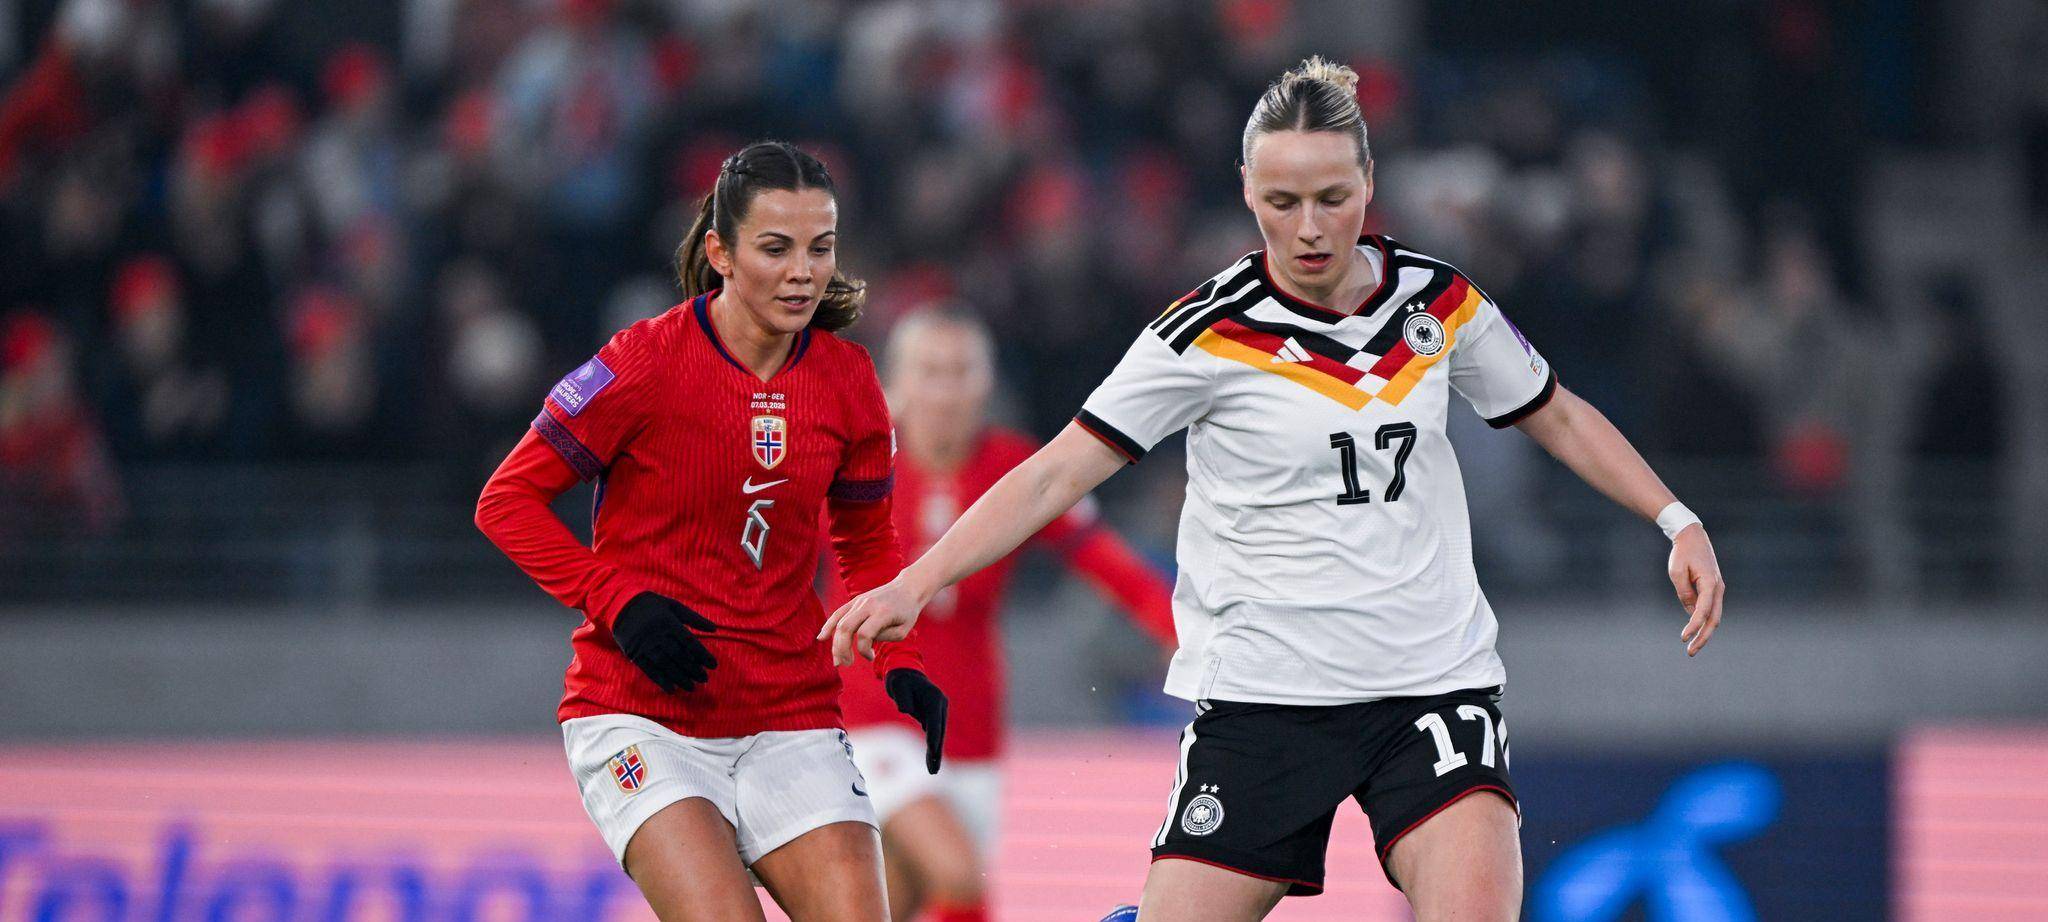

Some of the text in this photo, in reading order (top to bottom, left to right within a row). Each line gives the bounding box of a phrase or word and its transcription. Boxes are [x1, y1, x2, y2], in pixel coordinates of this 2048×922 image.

[1329, 421, 1418, 506] 17
[740, 499, 776, 571] 6
[1414, 704, 1496, 778] 17
